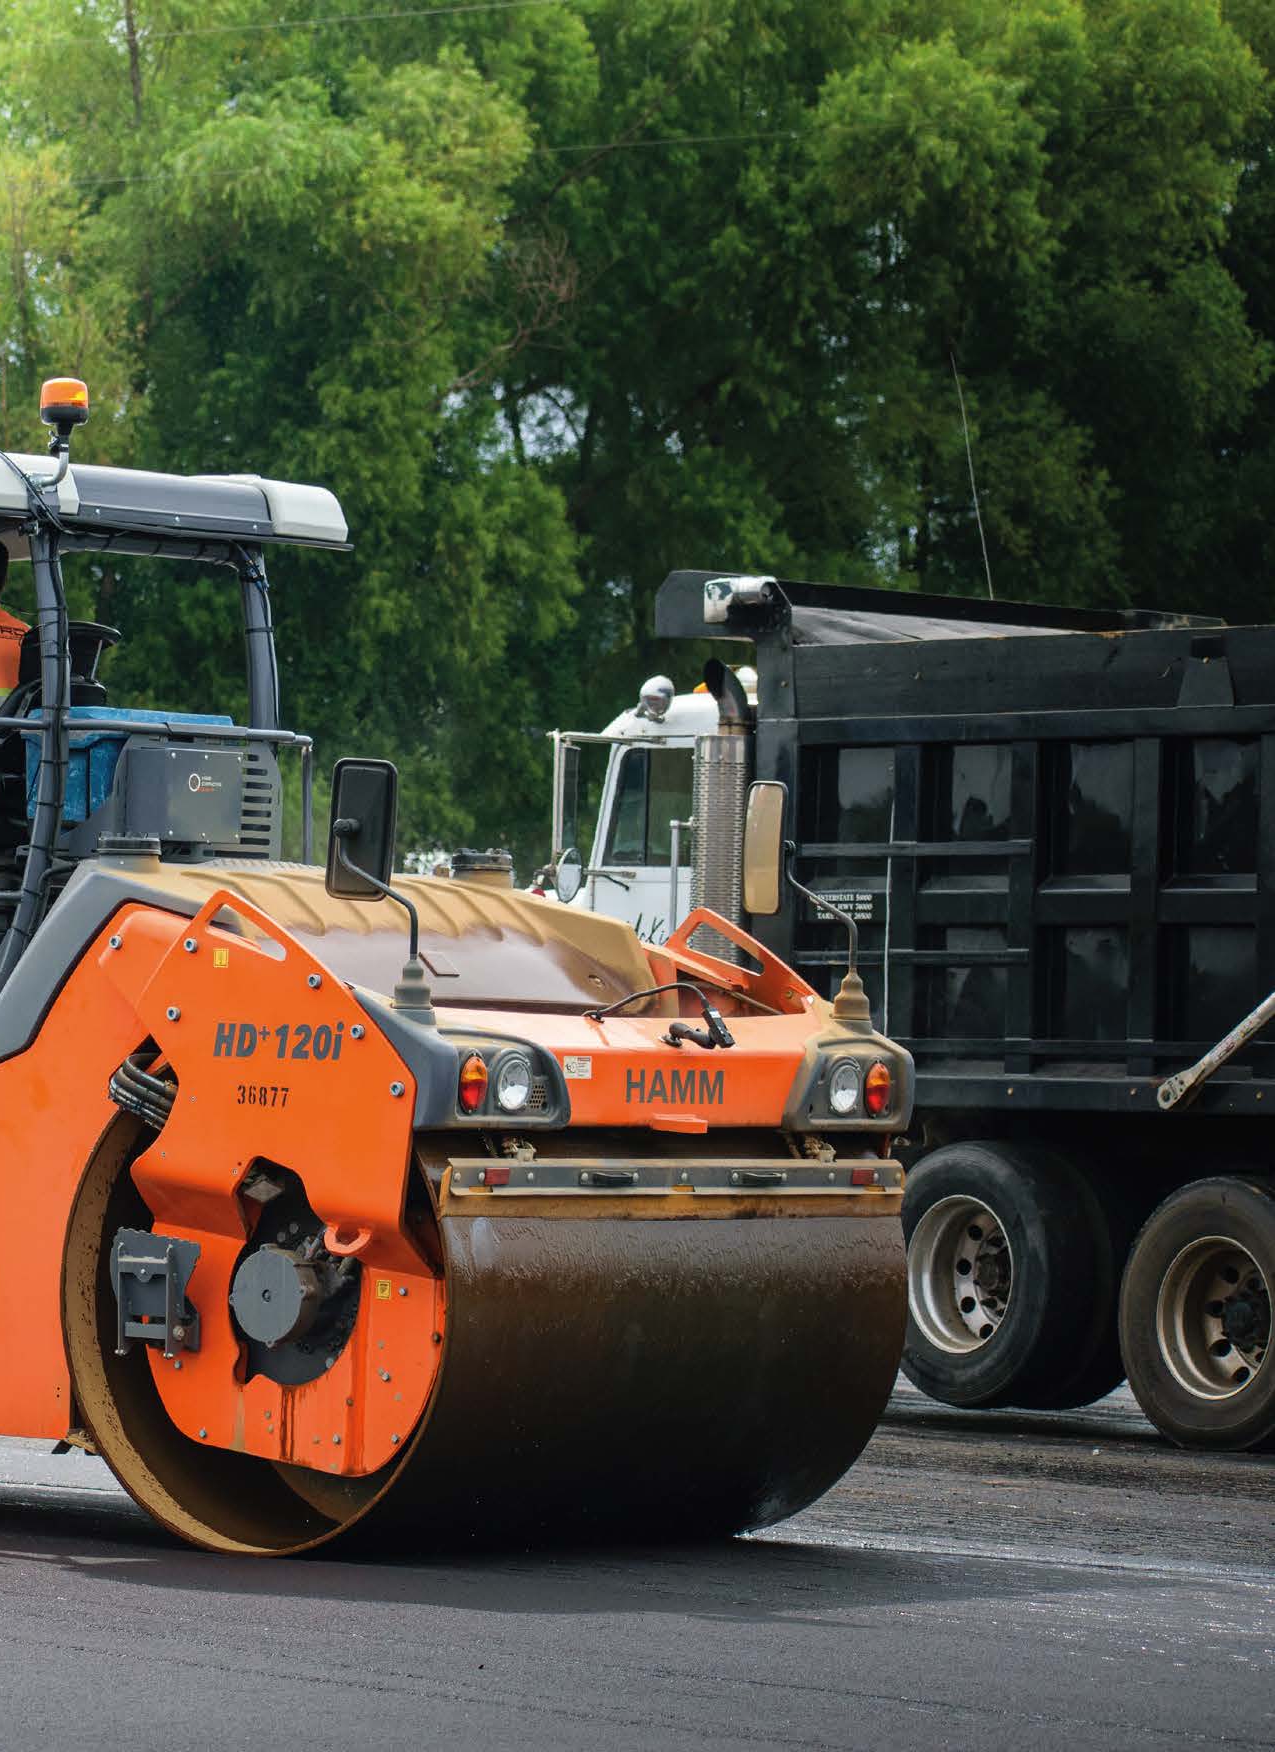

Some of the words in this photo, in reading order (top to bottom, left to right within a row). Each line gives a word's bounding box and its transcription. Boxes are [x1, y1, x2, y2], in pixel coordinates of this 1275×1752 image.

[275, 1021, 345, 1060] 120i
[237, 1085, 289, 1107] 36877
[625, 1068, 725, 1105] HAMM
